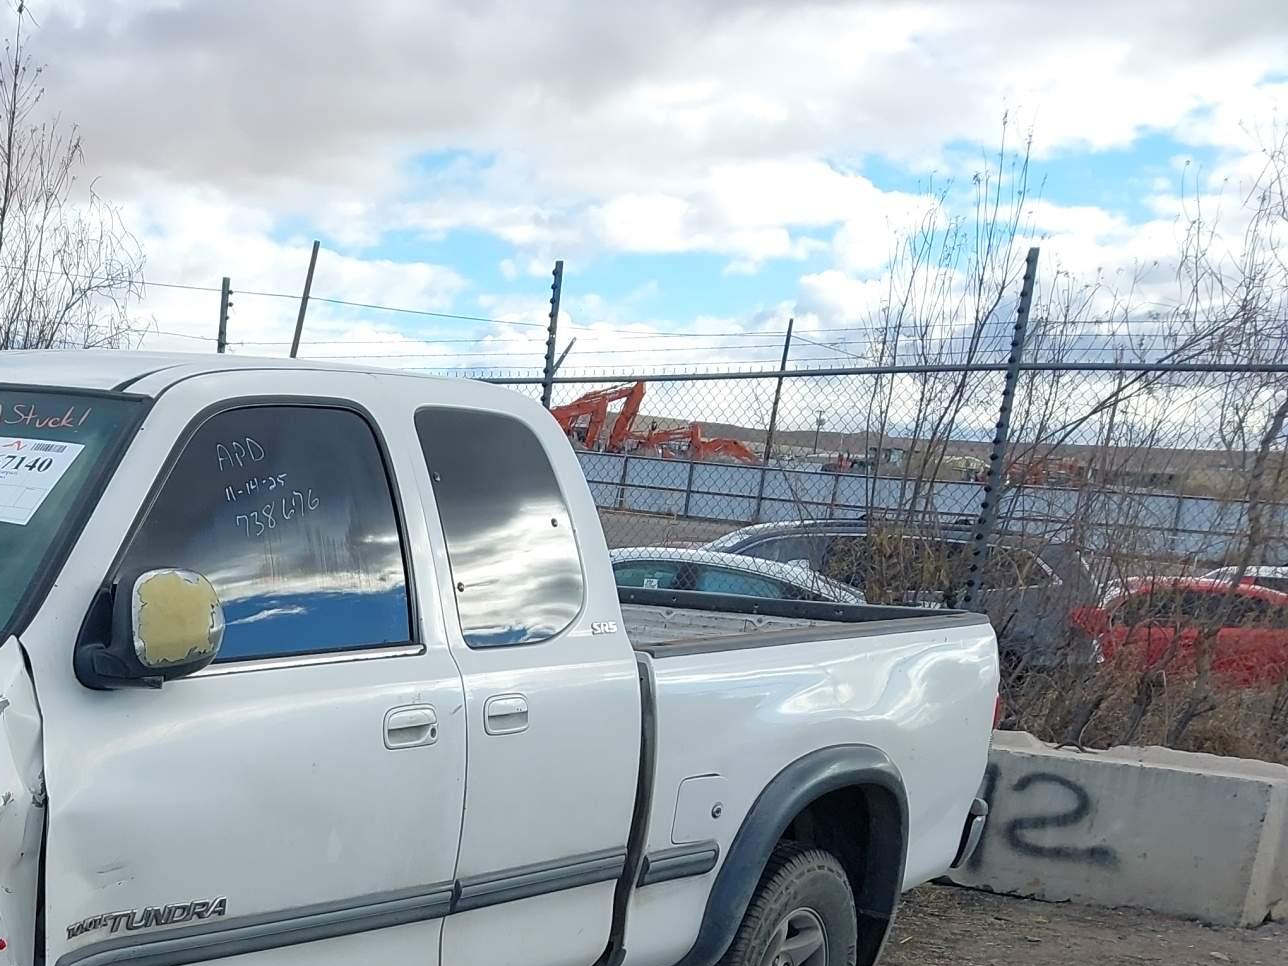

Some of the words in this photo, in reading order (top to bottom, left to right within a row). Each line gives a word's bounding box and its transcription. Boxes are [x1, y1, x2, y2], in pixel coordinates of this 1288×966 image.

[5, 404, 92, 432] Stuck!
[216, 437, 265, 471] APD
[592, 621, 617, 635] SR5
[110, 896, 228, 933] TUNDRA
